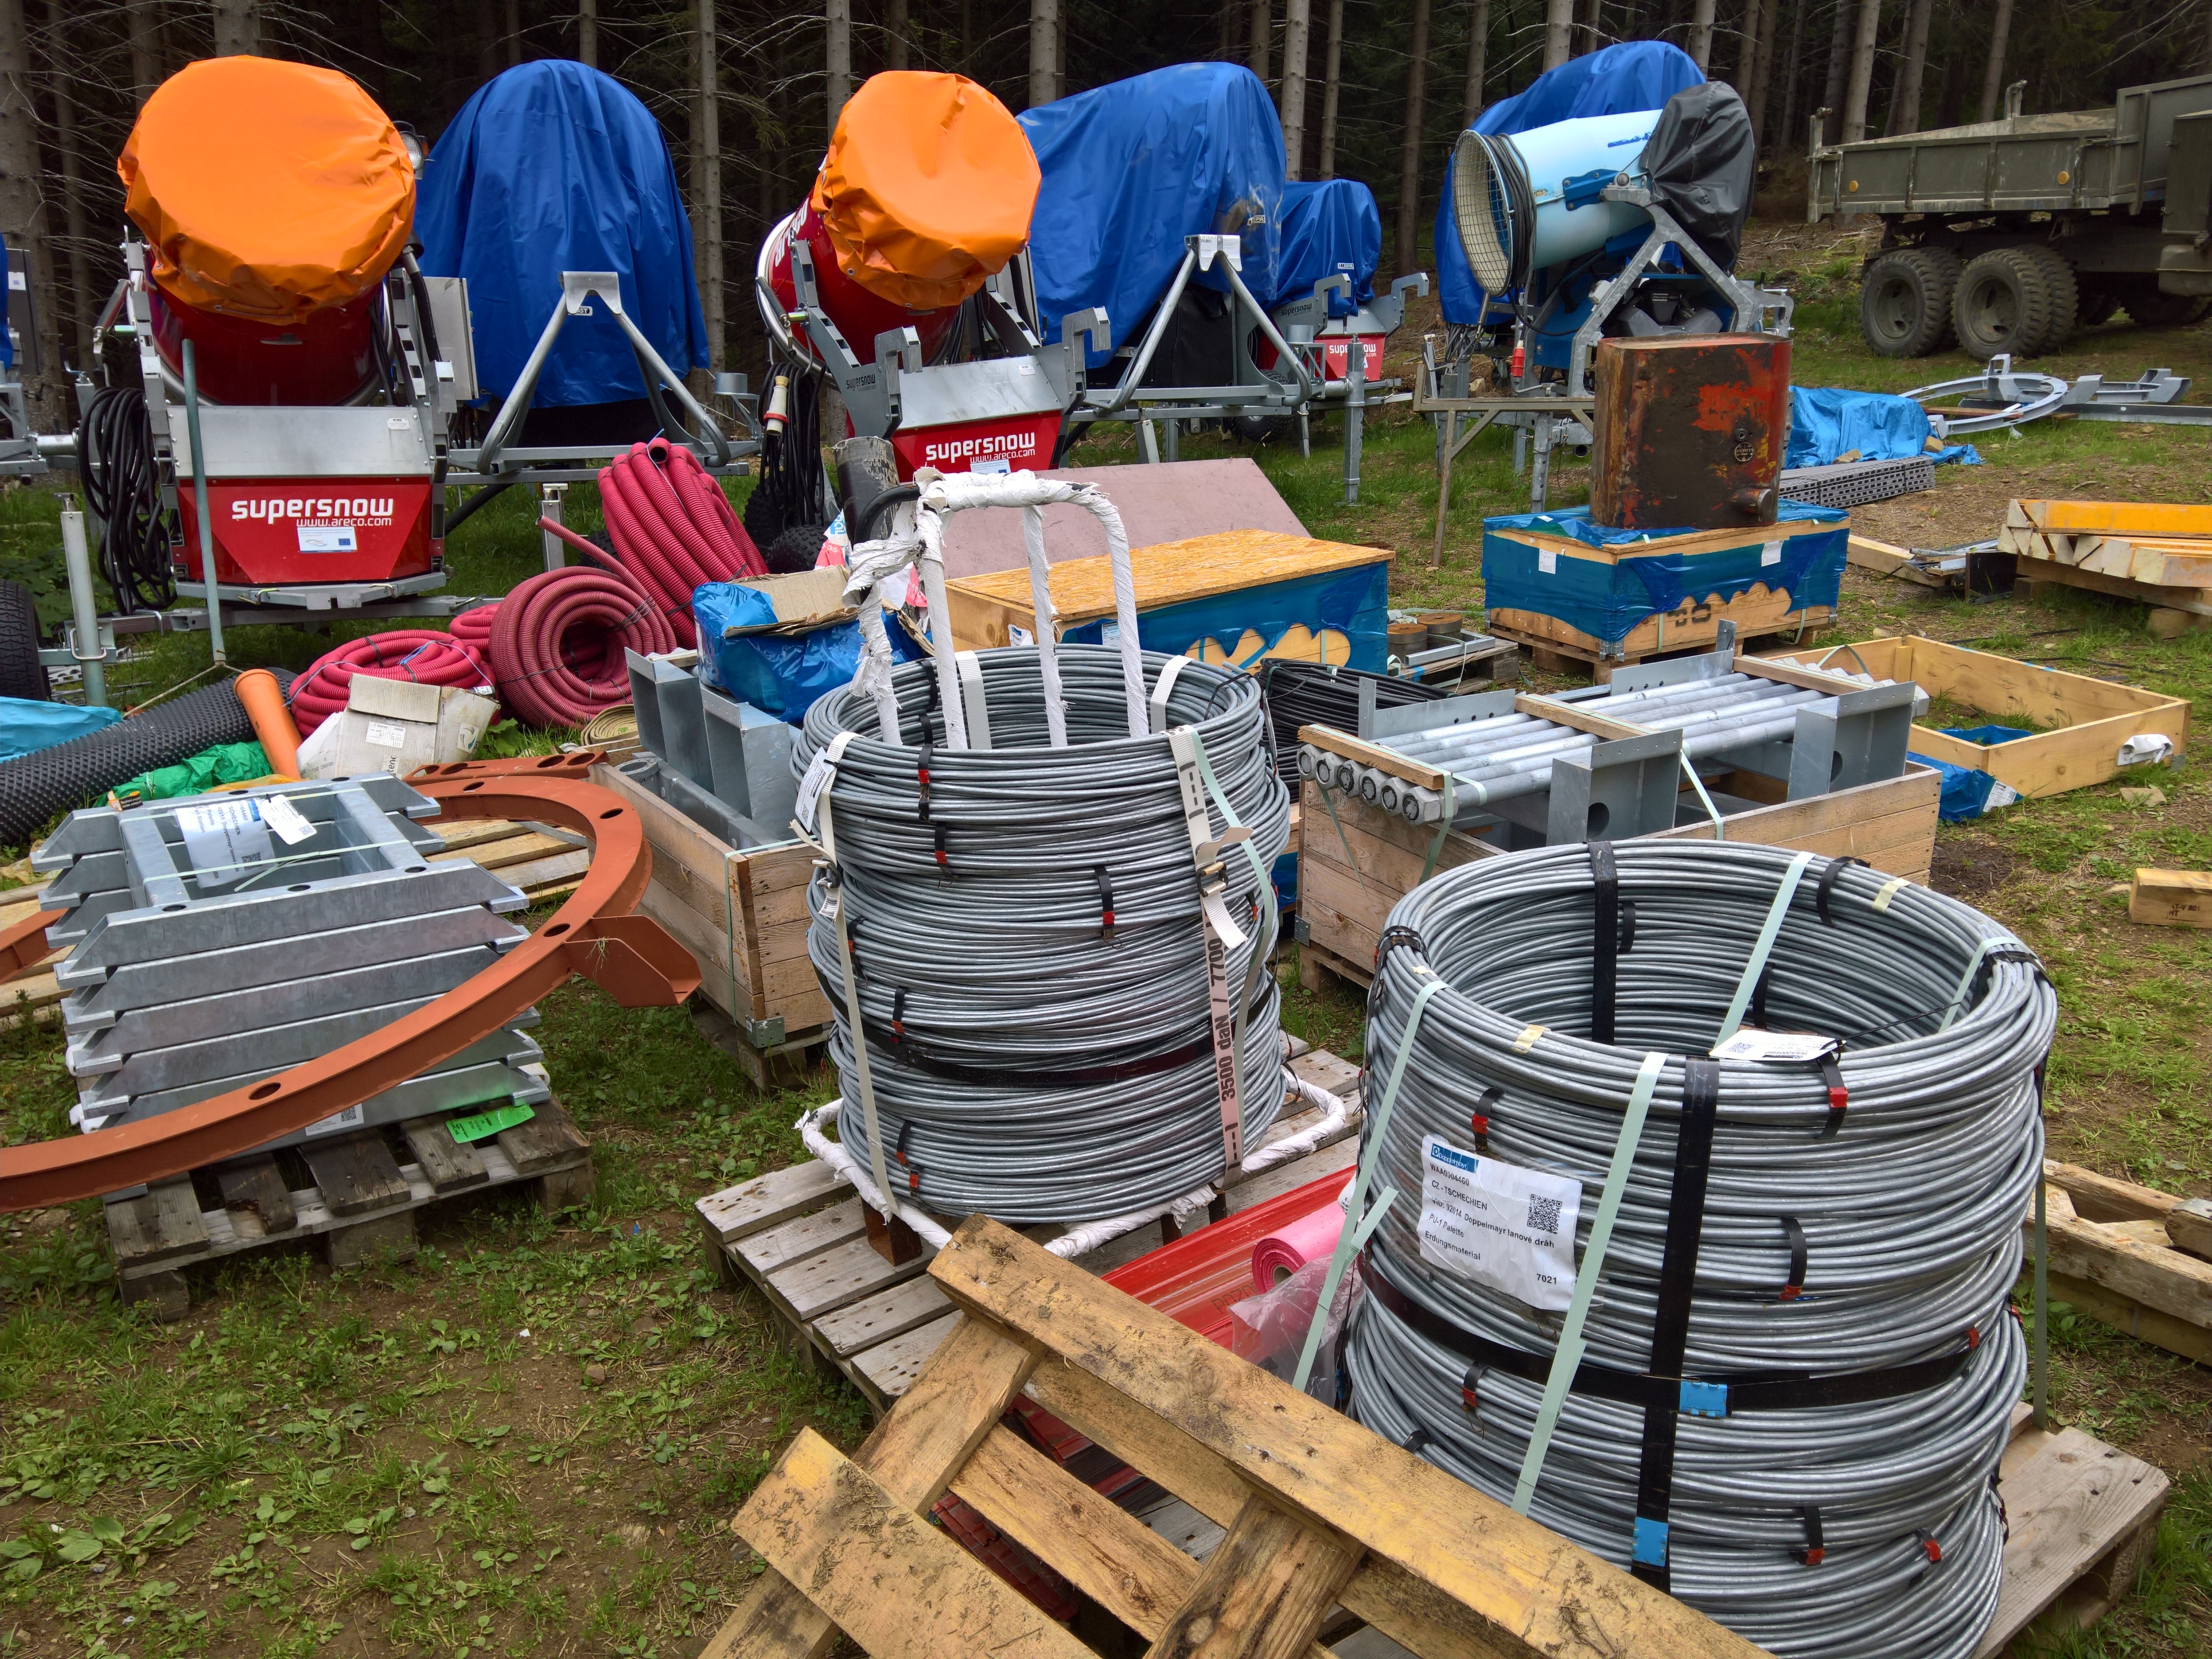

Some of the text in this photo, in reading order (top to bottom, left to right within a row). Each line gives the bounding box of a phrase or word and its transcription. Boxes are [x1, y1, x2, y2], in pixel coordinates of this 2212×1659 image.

[1281, 303, 1312, 316] supersnow
[846, 374, 876, 392] supersnow
[926, 432, 1035, 463] supersnow
[970, 448, 1035, 463] www.areco.com
[232, 498, 393, 524] supersnow
[296, 518, 392, 527] www.areco.com
[197, 816, 205, 833] Station
[222, 822, 233, 849] Doppelmayr
[1206, 938, 1226, 987] 7700
[1215, 1013, 1233, 1051] daN
[1219, 1055, 1236, 1103] 3500
[1438, 1153, 1468, 1170] Doppelmayr
[1430, 1163, 1470, 1186] WAA0004460
[1432, 1180, 1440, 1190] CZ
[1444, 1185, 1488, 1210] TSCHECHIEN
[1432, 1196, 1554, 1248] VID: 92014 Doppelmayr lanové dráh
[1443, 1220, 1464, 1238] Palette
[1425, 1230, 1481, 1260] Erdungsmaterial
[1536, 1273, 1557, 1285] 7021
